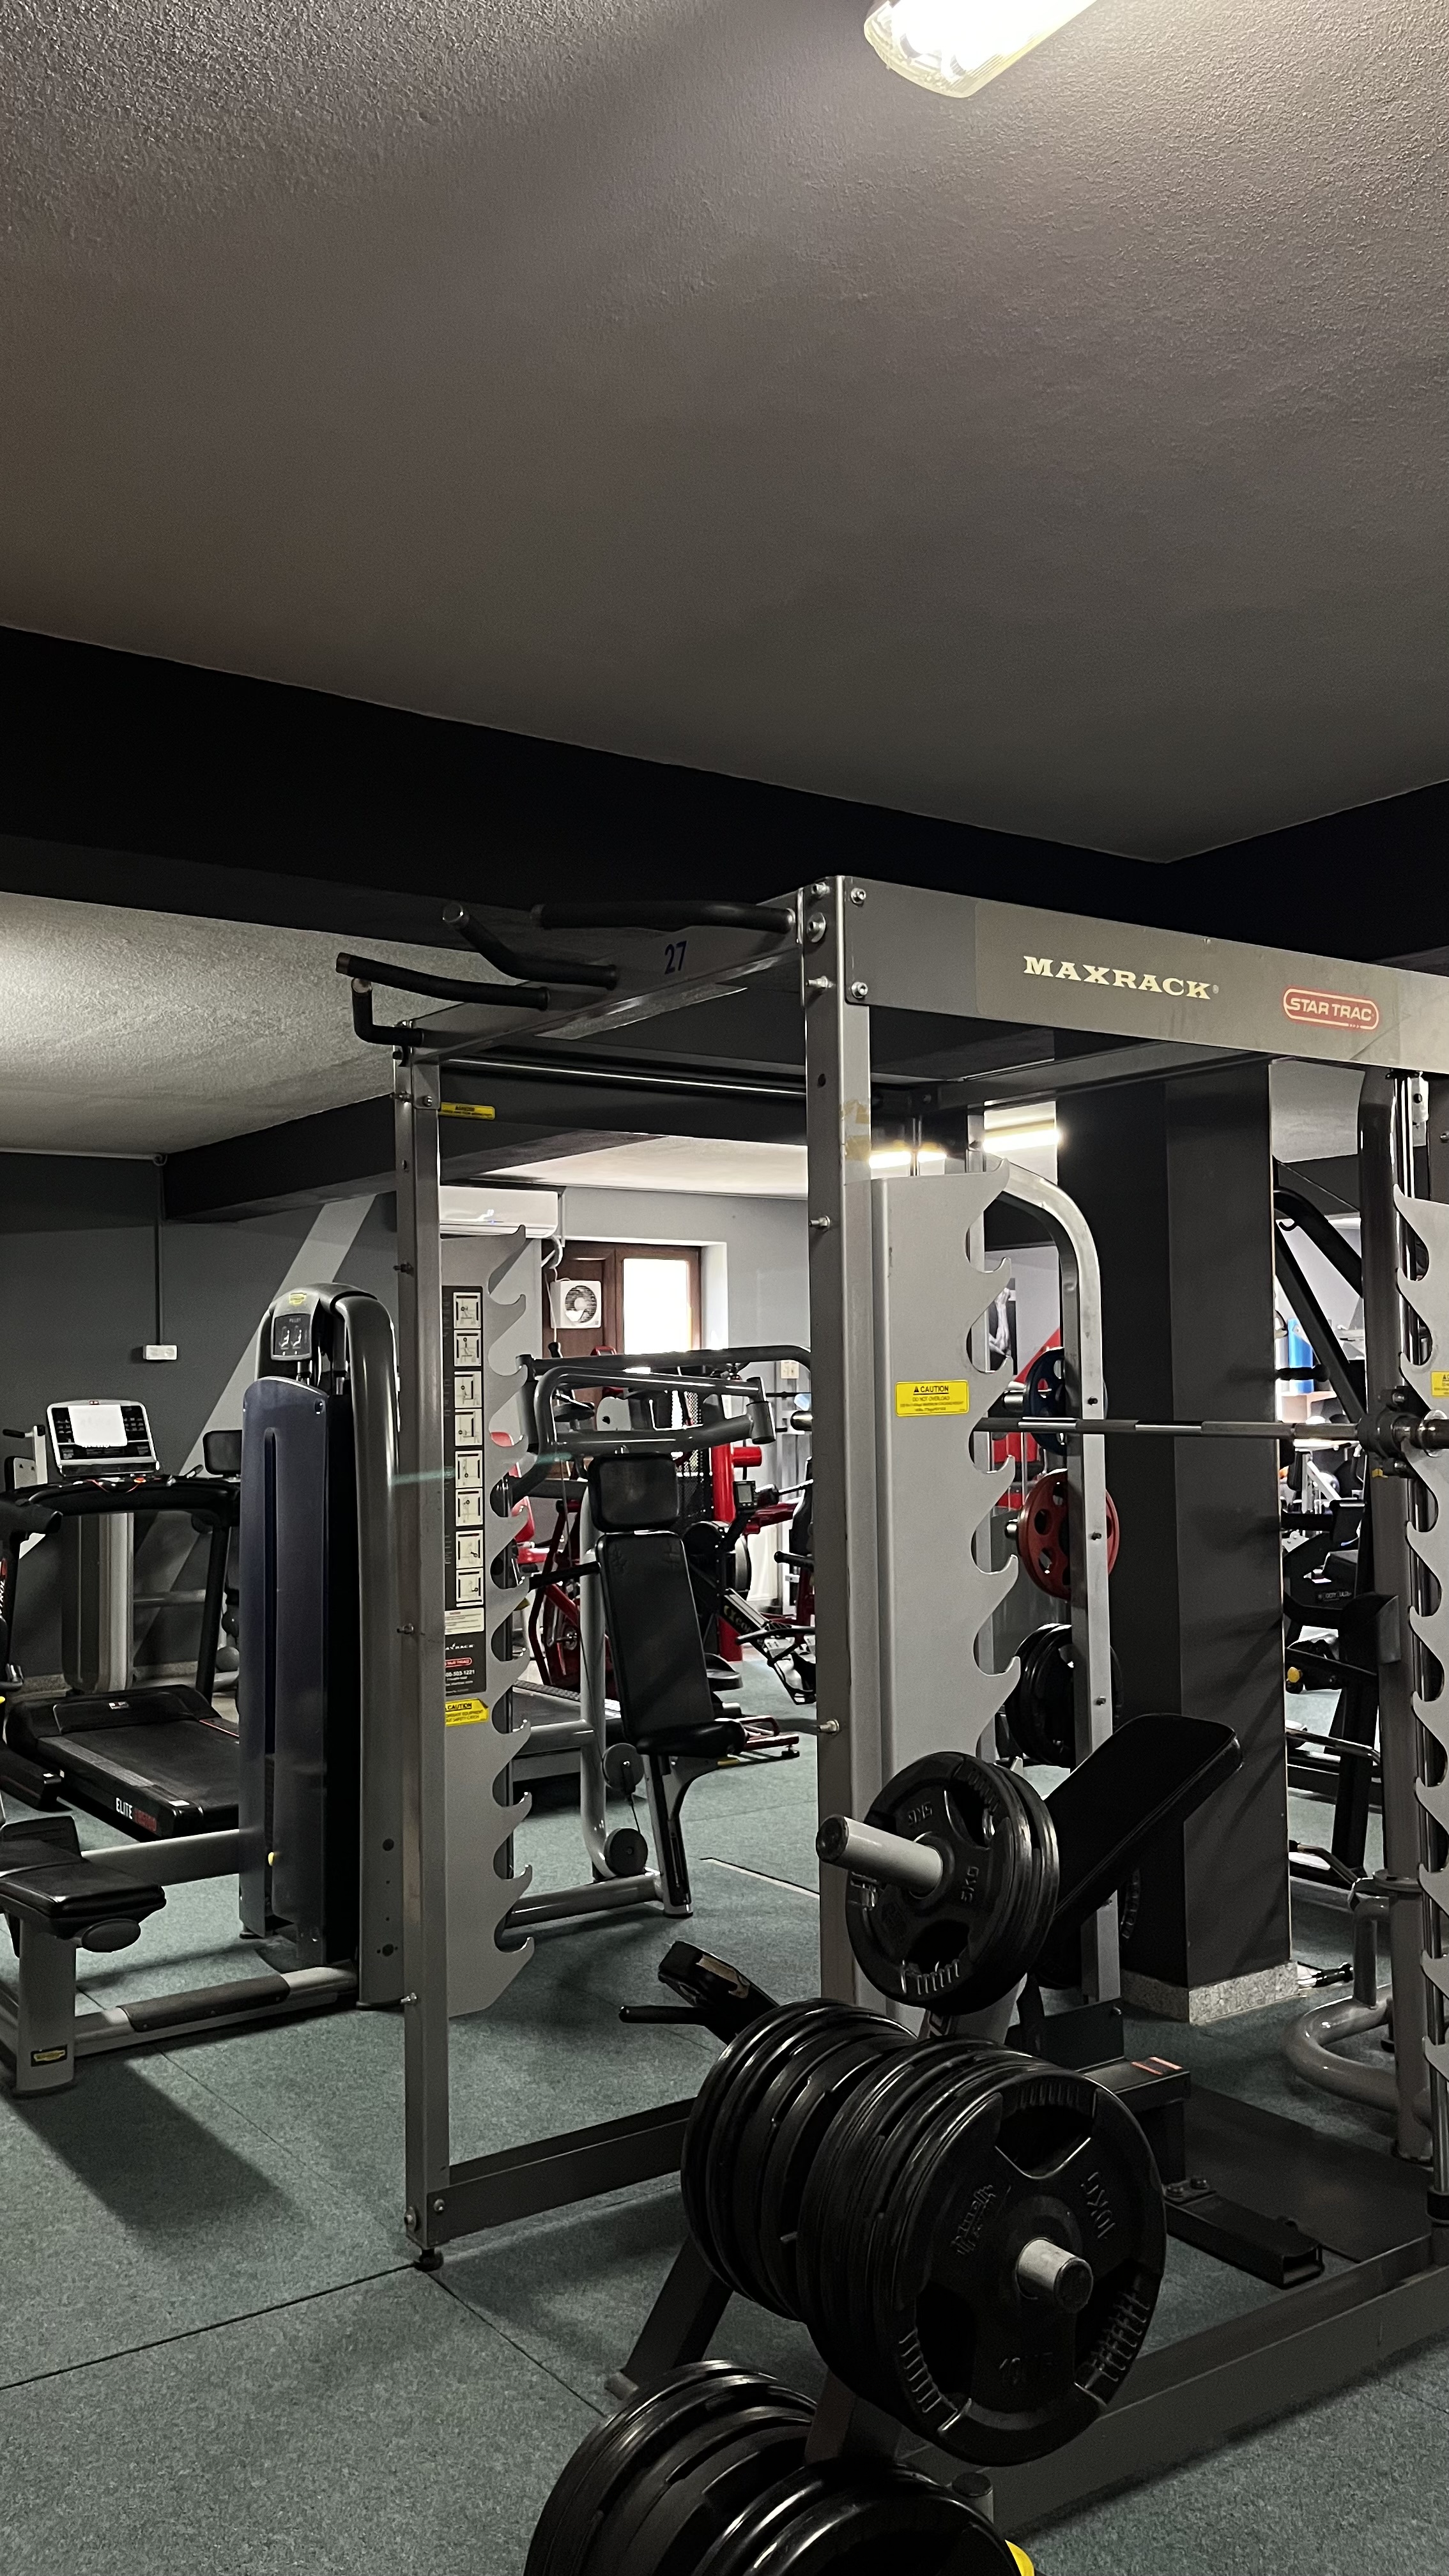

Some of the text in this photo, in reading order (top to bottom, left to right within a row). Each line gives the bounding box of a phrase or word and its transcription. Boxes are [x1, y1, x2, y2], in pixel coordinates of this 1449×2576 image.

[664, 940, 687, 974] 27
[1023, 956, 1211, 1000] MAXRACK
[1287, 997, 1372, 1022] STAR TRAC
[116, 1797, 133, 1820] ELITE
